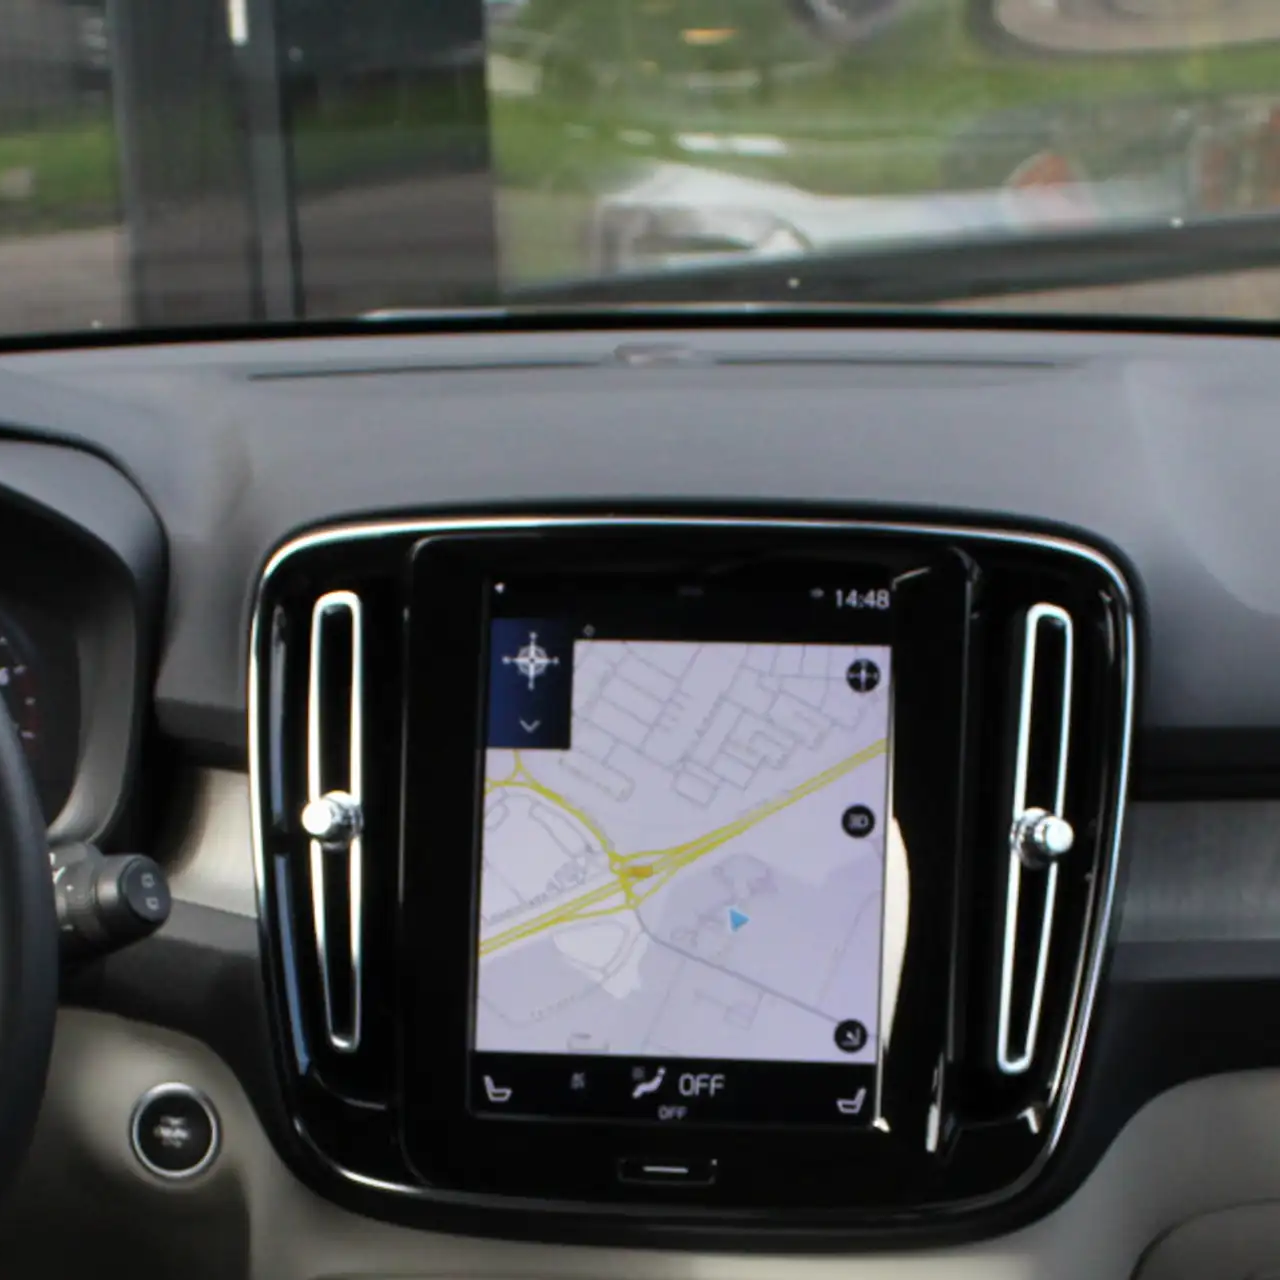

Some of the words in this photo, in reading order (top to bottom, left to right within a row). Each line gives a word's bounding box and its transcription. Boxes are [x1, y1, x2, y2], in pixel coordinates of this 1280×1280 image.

[834, 588, 891, 610] 14:48
[678, 1072, 726, 1097] OFF
[657, 1105, 688, 1121] OFF
